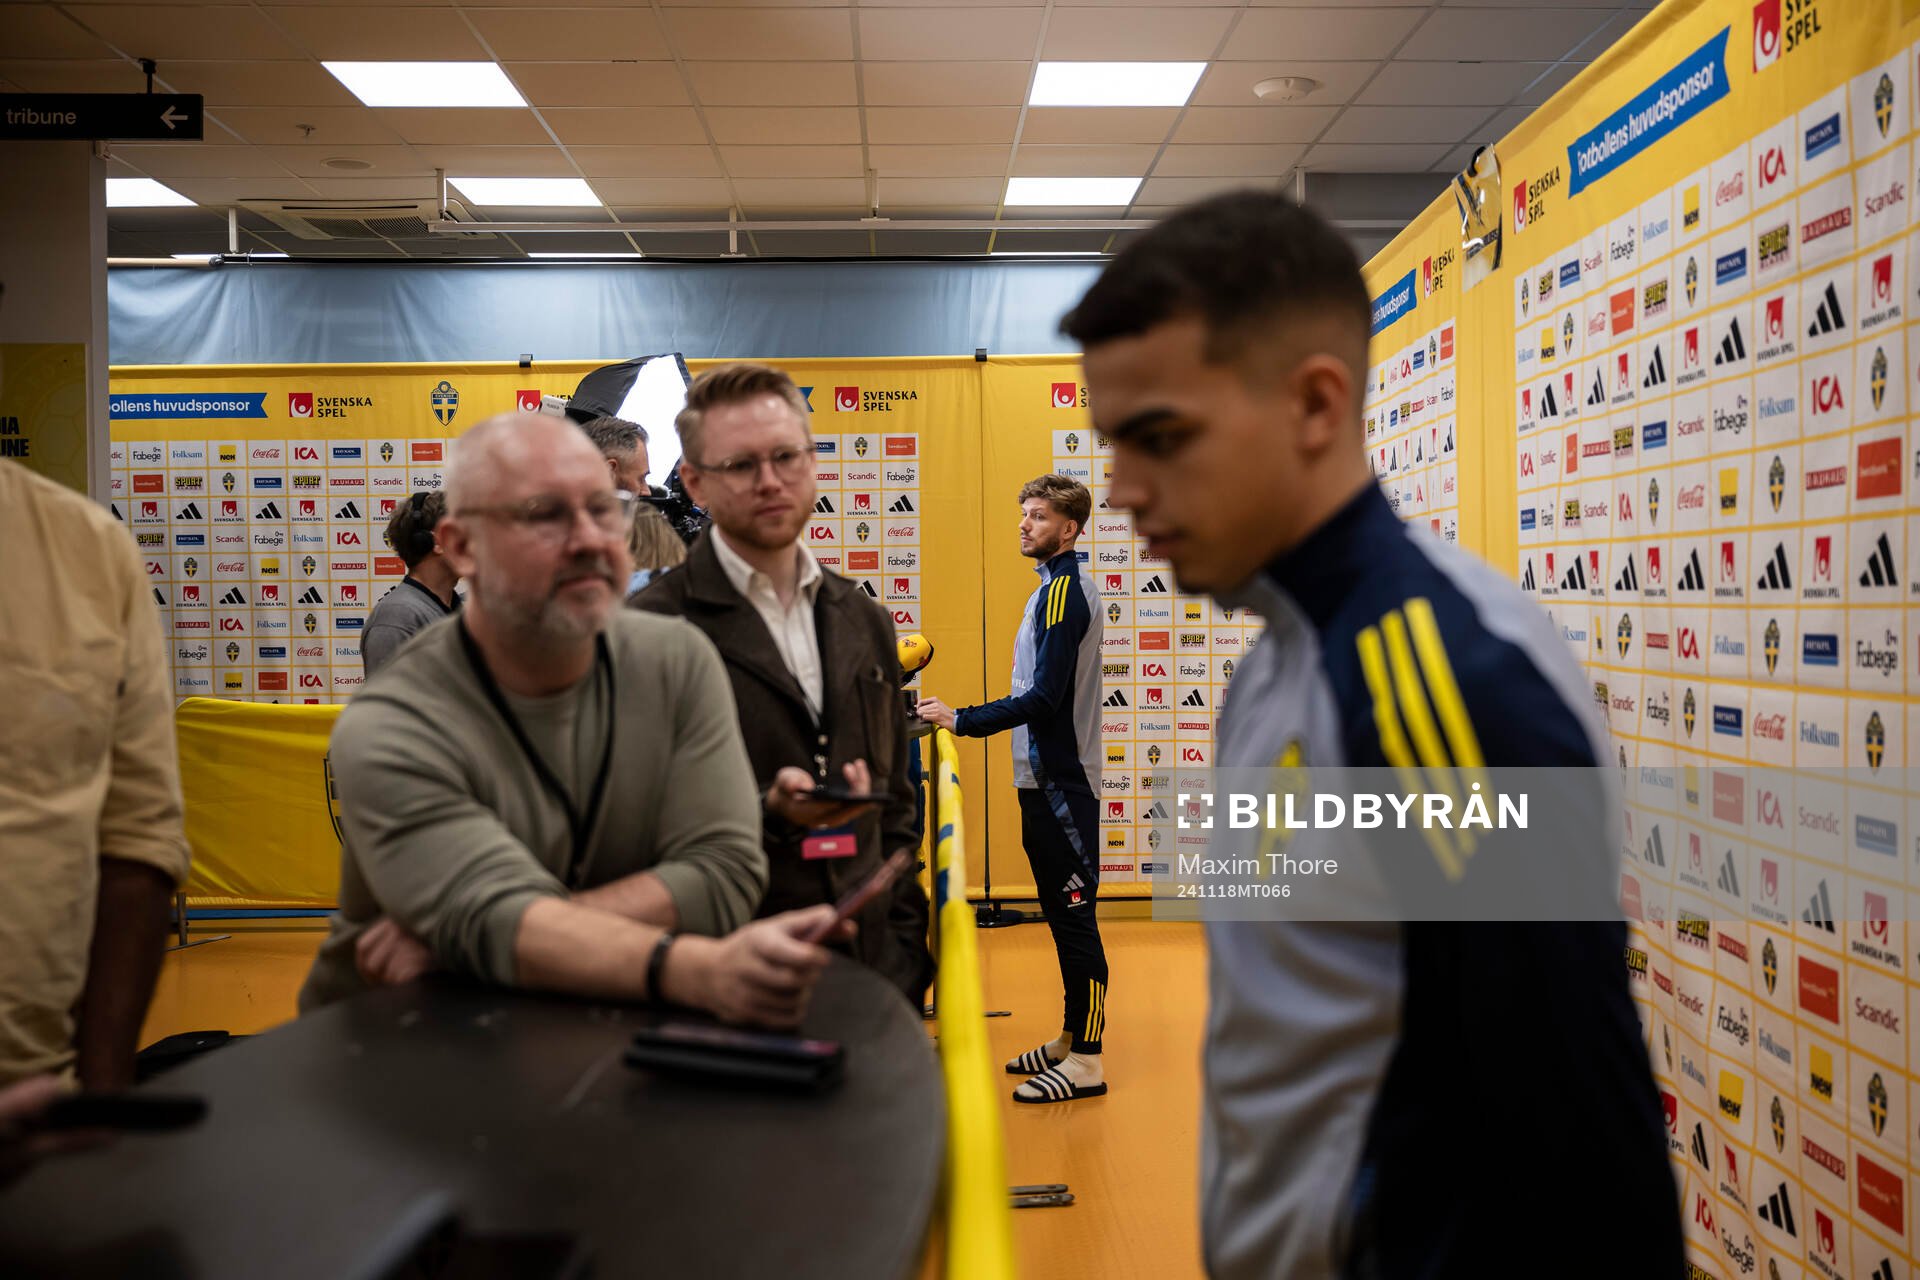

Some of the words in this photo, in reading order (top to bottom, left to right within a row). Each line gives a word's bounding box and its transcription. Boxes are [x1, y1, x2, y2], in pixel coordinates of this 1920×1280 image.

[1786, 15, 1822, 52] SPEL
[1629, 61, 1715, 140] huvudsponsor
[7, 109, 76, 124] tribune
[1760, 146, 1786, 188] ICA
[1865, 182, 1904, 216] Scandic
[1760, 224, 1789, 257] SPORT
[864, 391, 917, 400] SVENSKA
[1813, 374, 1844, 415] ICA
[154, 400, 250, 416] huvudsponsor
[318, 397, 372, 407] SVENSKA
[864, 402, 892, 411] SPEL
[1759, 397, 1795, 419] Folksam
[318, 409, 346, 417] SPEL
[133, 451, 161, 462] Fabege
[173, 451, 202, 459] Folksam
[295, 448, 318, 459] ICA
[1521, 452, 1533, 477] ICA
[176, 477, 202, 486] SPORT
[293, 476, 320, 484] SPORT
[414, 478, 441, 488] Fabege
[887, 472, 914, 482] Fabege
[1619, 492, 1632, 522] ICA
[811, 527, 834, 539] ICA
[1099, 524, 1127, 532] Scandic
[137, 534, 164, 543] SPORT
[255, 535, 283, 546] Fabege
[337, 532, 360, 544] ICA
[888, 556, 915, 567] Fabege
[1100, 552, 1127, 563] Fabege
[1140, 609, 1168, 617] Folksam
[220, 618, 244, 631] ICA
[1181, 634, 1205, 643] SPORT
[1677, 628, 1699, 659] ICA
[1714, 635, 1745, 656] Folksam
[179, 650, 206, 660] Fabege
[1857, 641, 1898, 676] Fabege
[1103, 665, 1129, 673] SPORT
[1143, 664, 1166, 676] ICA
[1181, 666, 1205, 677] Fabege
[180, 678, 208, 686] Folksam
[300, 675, 323, 687] ICA
[1801, 722, 1839, 748] Folksam
[1183, 749, 1203, 761] ICA
[1102, 780, 1130, 790] Fabege
[1142, 777, 1168, 786] SPORT
[1757, 789, 1784, 829] ICA
[1799, 806, 1839, 835] Scandic
[1678, 912, 1709, 941] SPORT
[1855, 997, 1899, 1034] Scandic
[1718, 1005, 1749, 1046] Fabege
